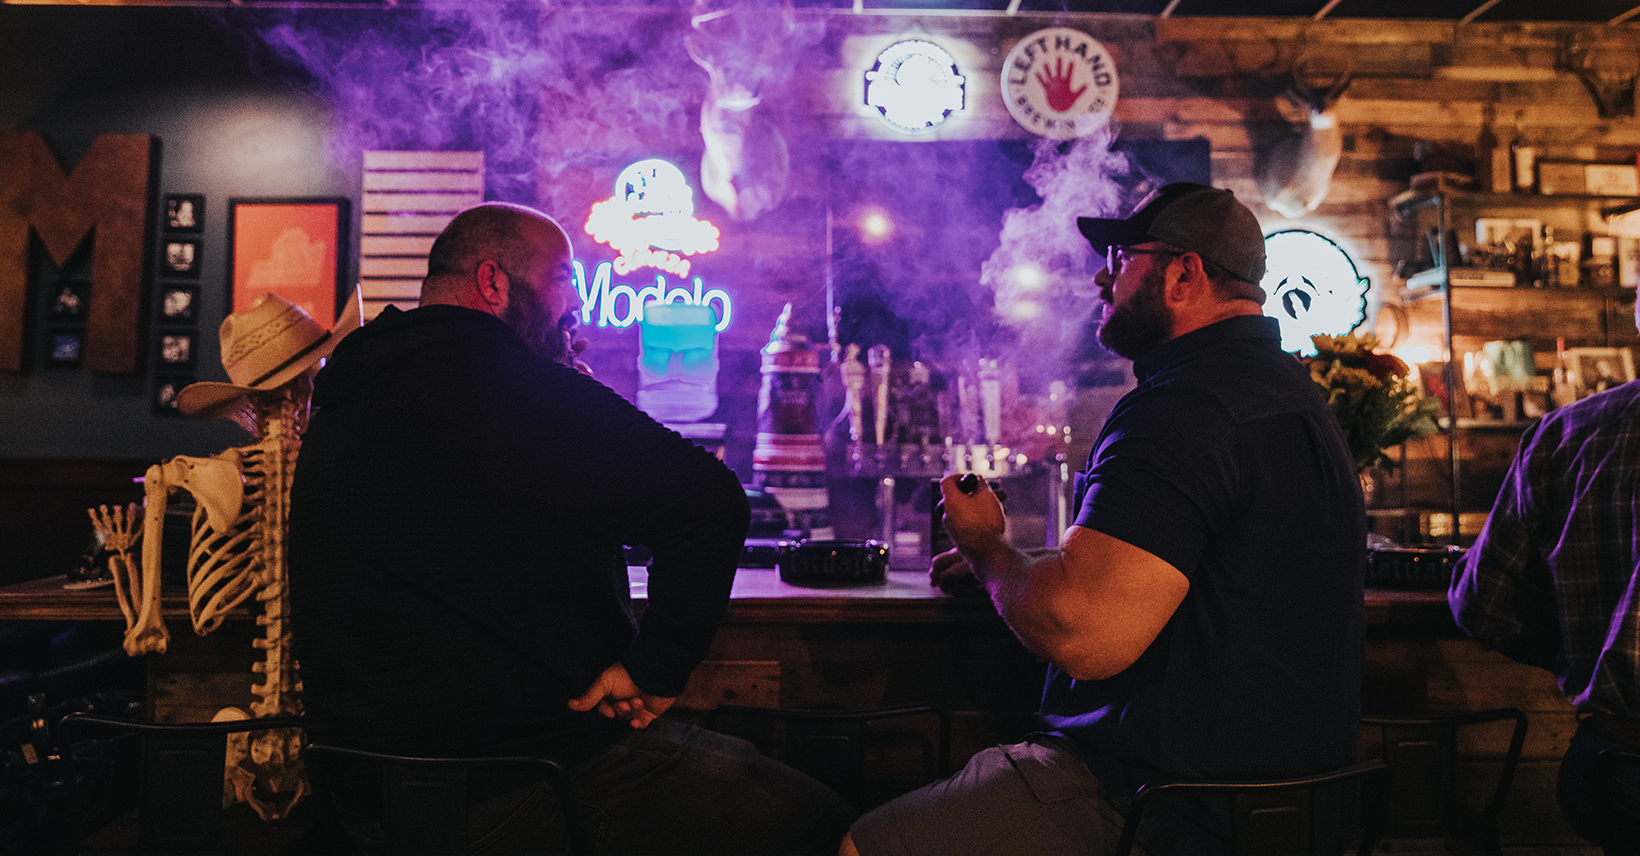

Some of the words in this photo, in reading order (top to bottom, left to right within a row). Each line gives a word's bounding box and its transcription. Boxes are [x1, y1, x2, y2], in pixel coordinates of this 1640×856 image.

[1010, 36, 1048, 86] LEFT
[1054, 34, 1112, 87] HAND
[1015, 95, 1079, 129] BREWIN
[0, 132, 152, 373] M
